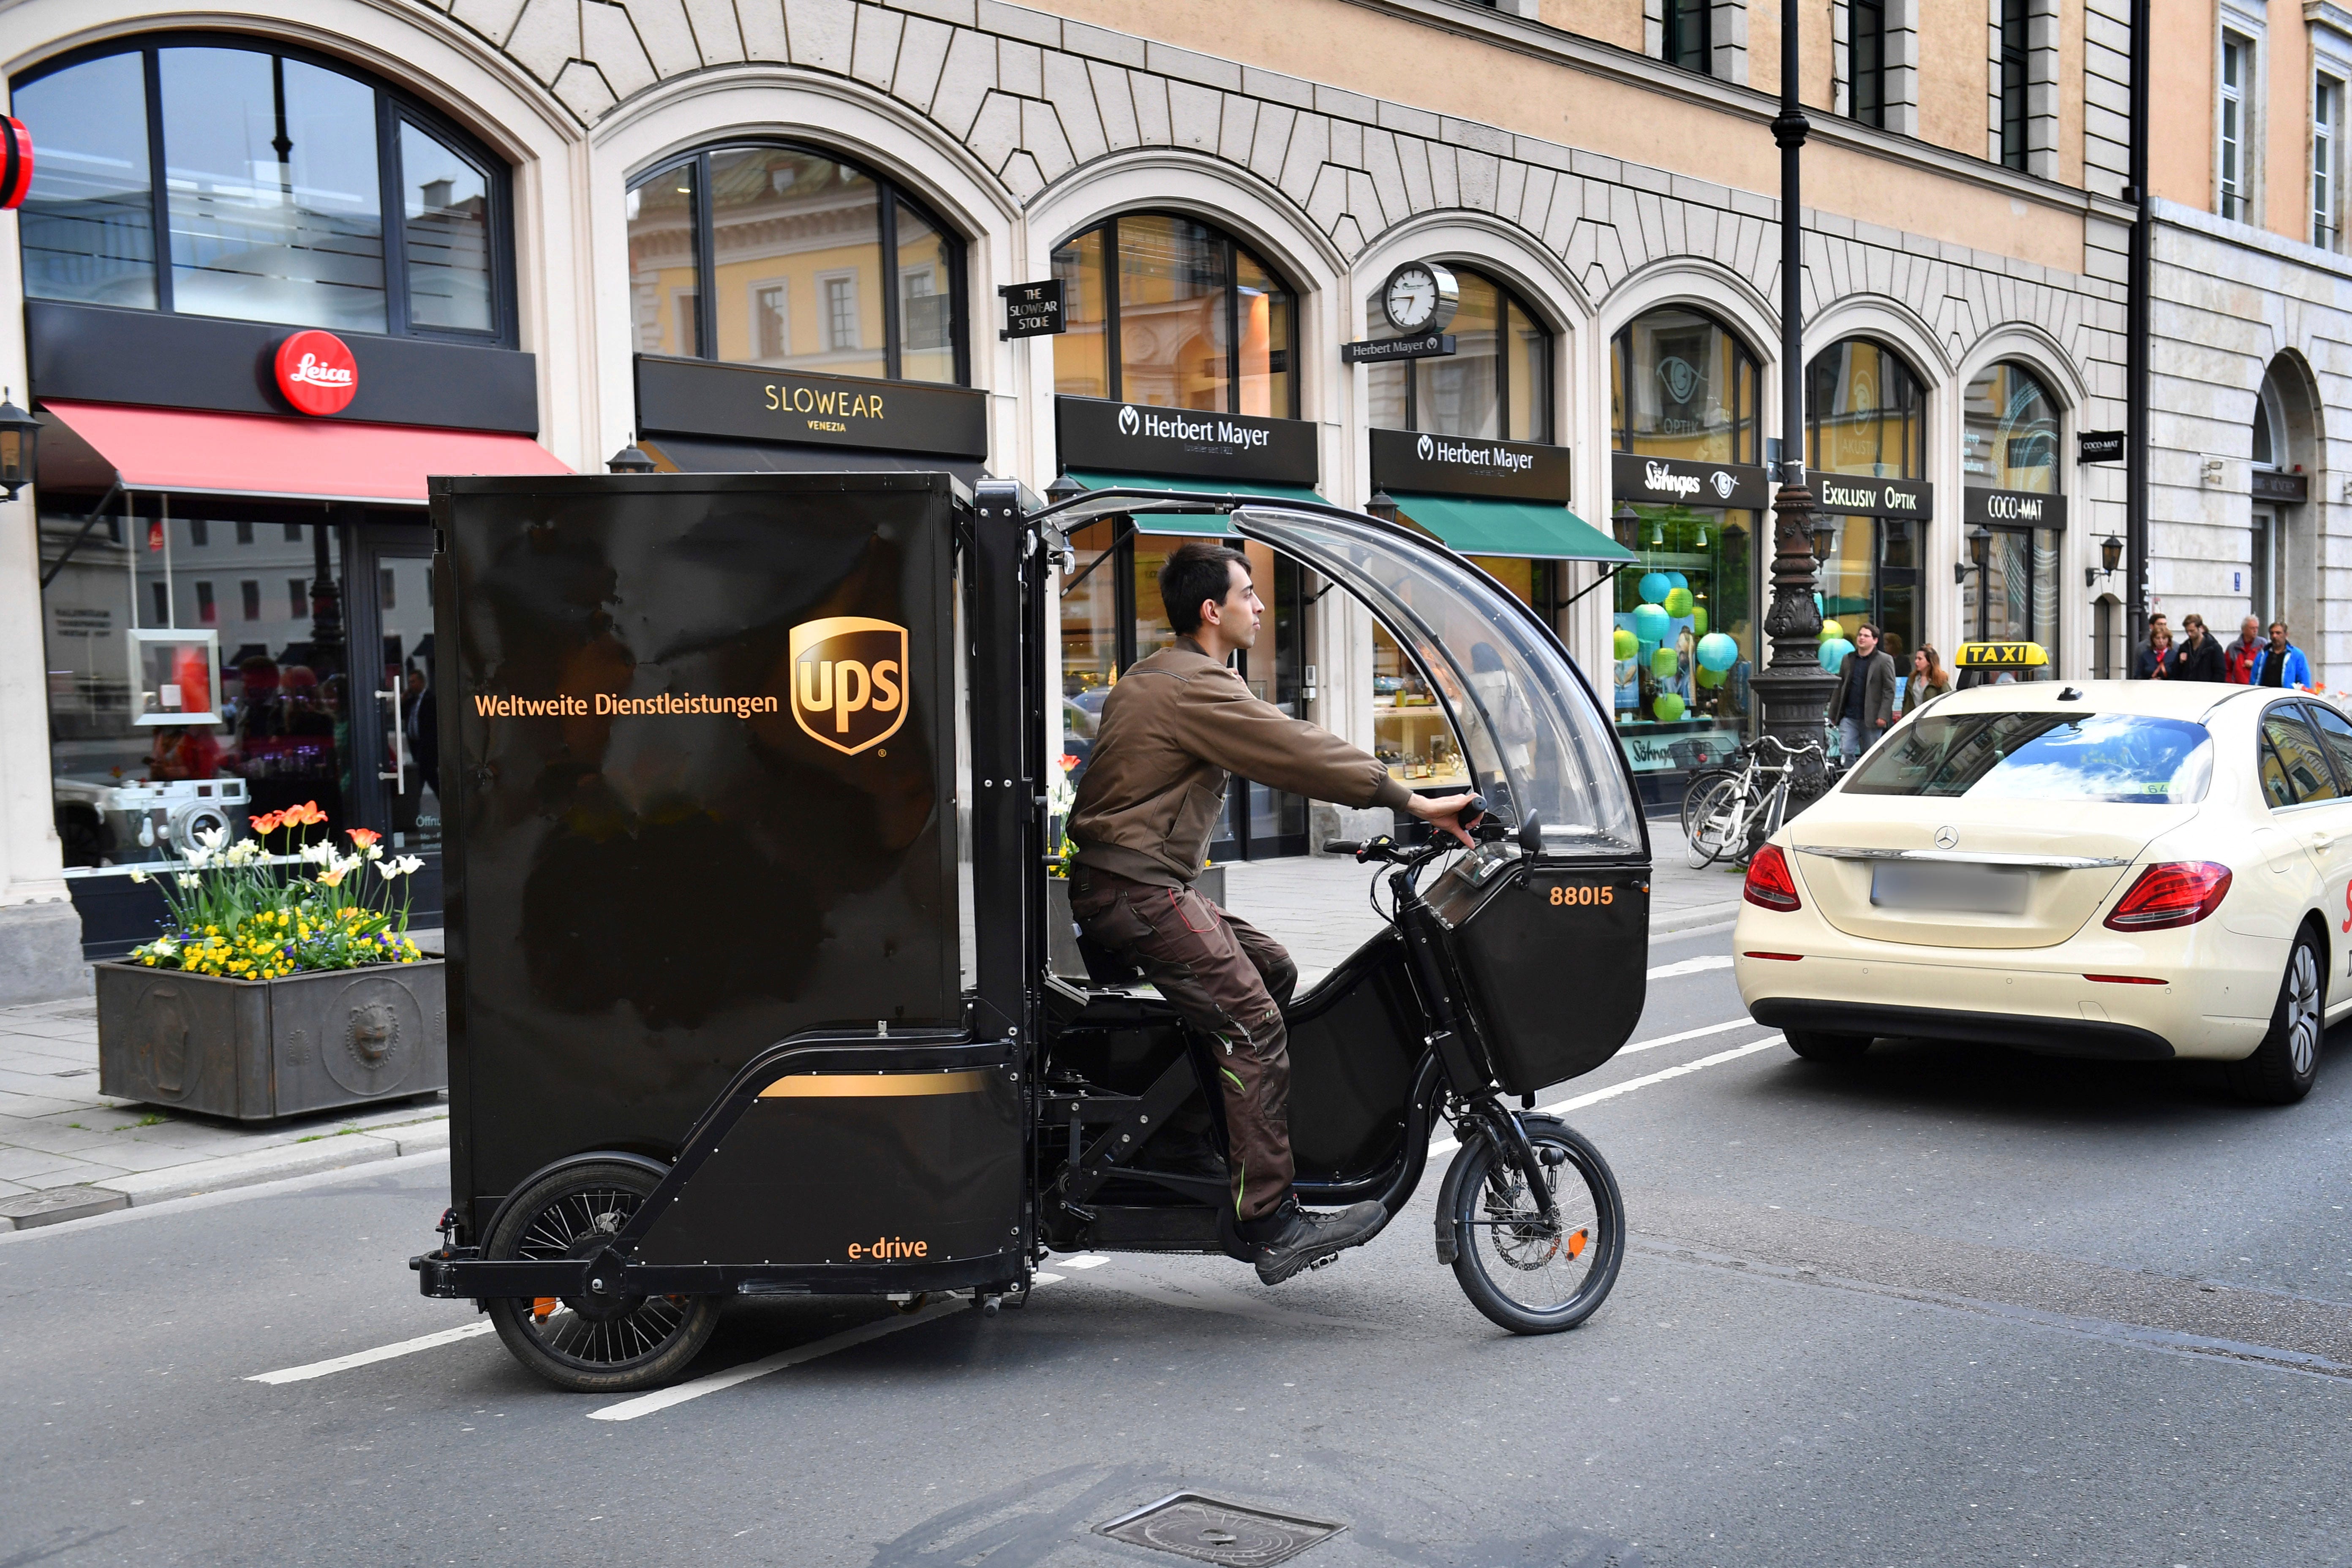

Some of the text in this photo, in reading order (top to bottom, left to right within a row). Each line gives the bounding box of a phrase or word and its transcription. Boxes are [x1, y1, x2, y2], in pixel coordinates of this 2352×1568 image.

[1024, 288, 1042, 300] THE
[1009, 301, 1057, 317] SLOWEAR
[1018, 316, 1050, 329] STORE
[1353, 341, 1424, 356] Herbert Mayer
[290, 353, 353, 387] Leica
[765, 384, 884, 419] SLOWEAR
[806, 420, 846, 432] VENEZIA
[1145, 414, 1269, 449] Herbert Mayer
[1664, 418, 1699, 437] OPTIK
[2083, 440, 2119, 450] COCO-MAT
[1437, 442, 1534, 472] Herbert Mayer
[1644, 460, 1701, 499] Söhnges
[1823, 480, 1917, 510] EXKLUSIV OPTIK
[1988, 495, 2043, 521] COCO-MAT
[1969, 647, 2025, 663] TAXI
[475, 692, 778, 719] Weltweite Dienstleistungen
[1550, 886, 1614, 906] 88015
[848, 1236, 928, 1259] e-drive
